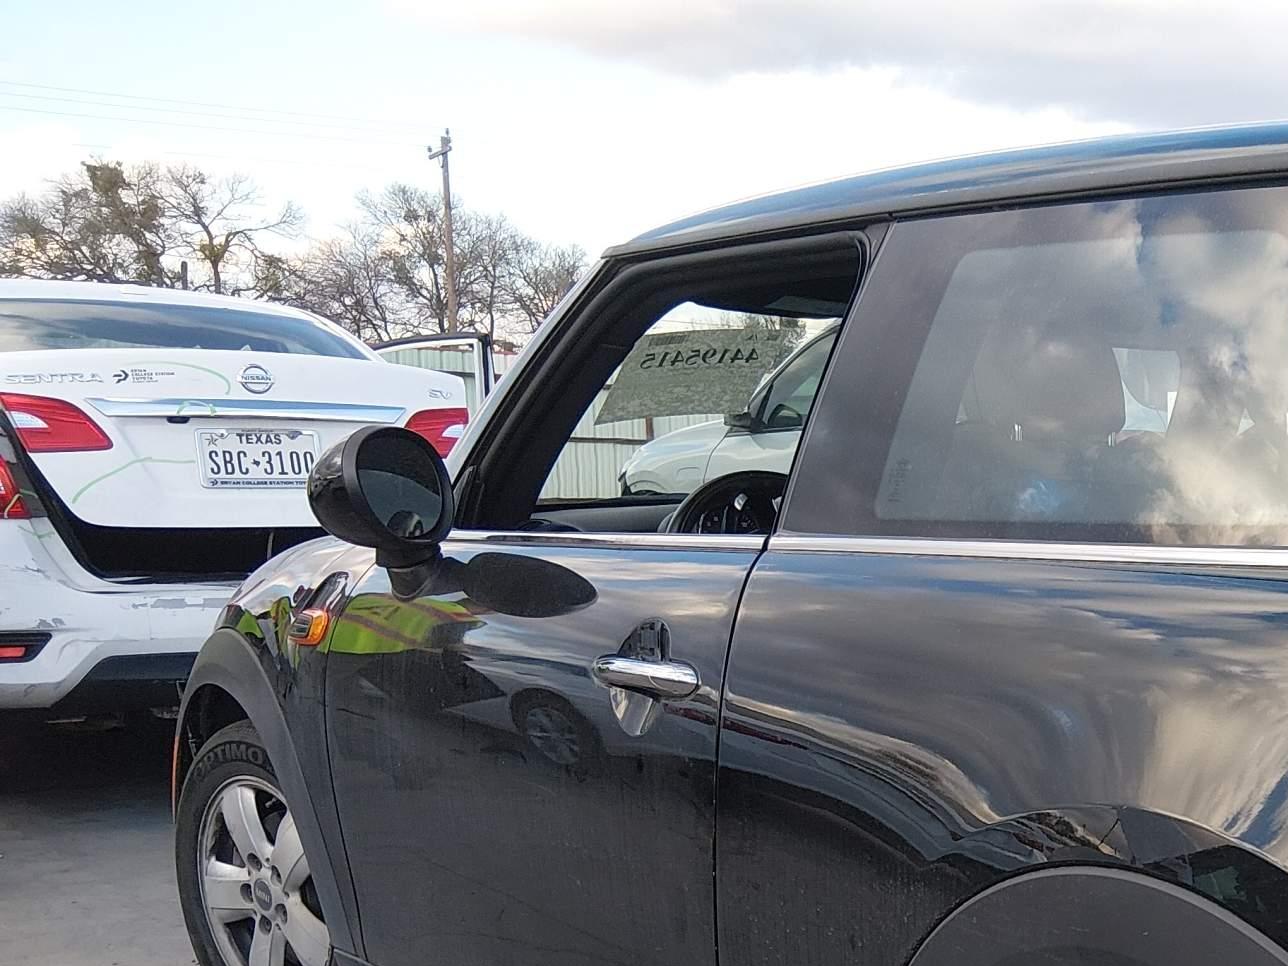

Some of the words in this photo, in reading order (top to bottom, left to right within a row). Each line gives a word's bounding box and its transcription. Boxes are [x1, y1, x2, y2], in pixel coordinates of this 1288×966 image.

[6, 373, 104, 384] SENTRA
[428, 389, 451, 400] SV
[236, 433, 282, 445] TEXAS
